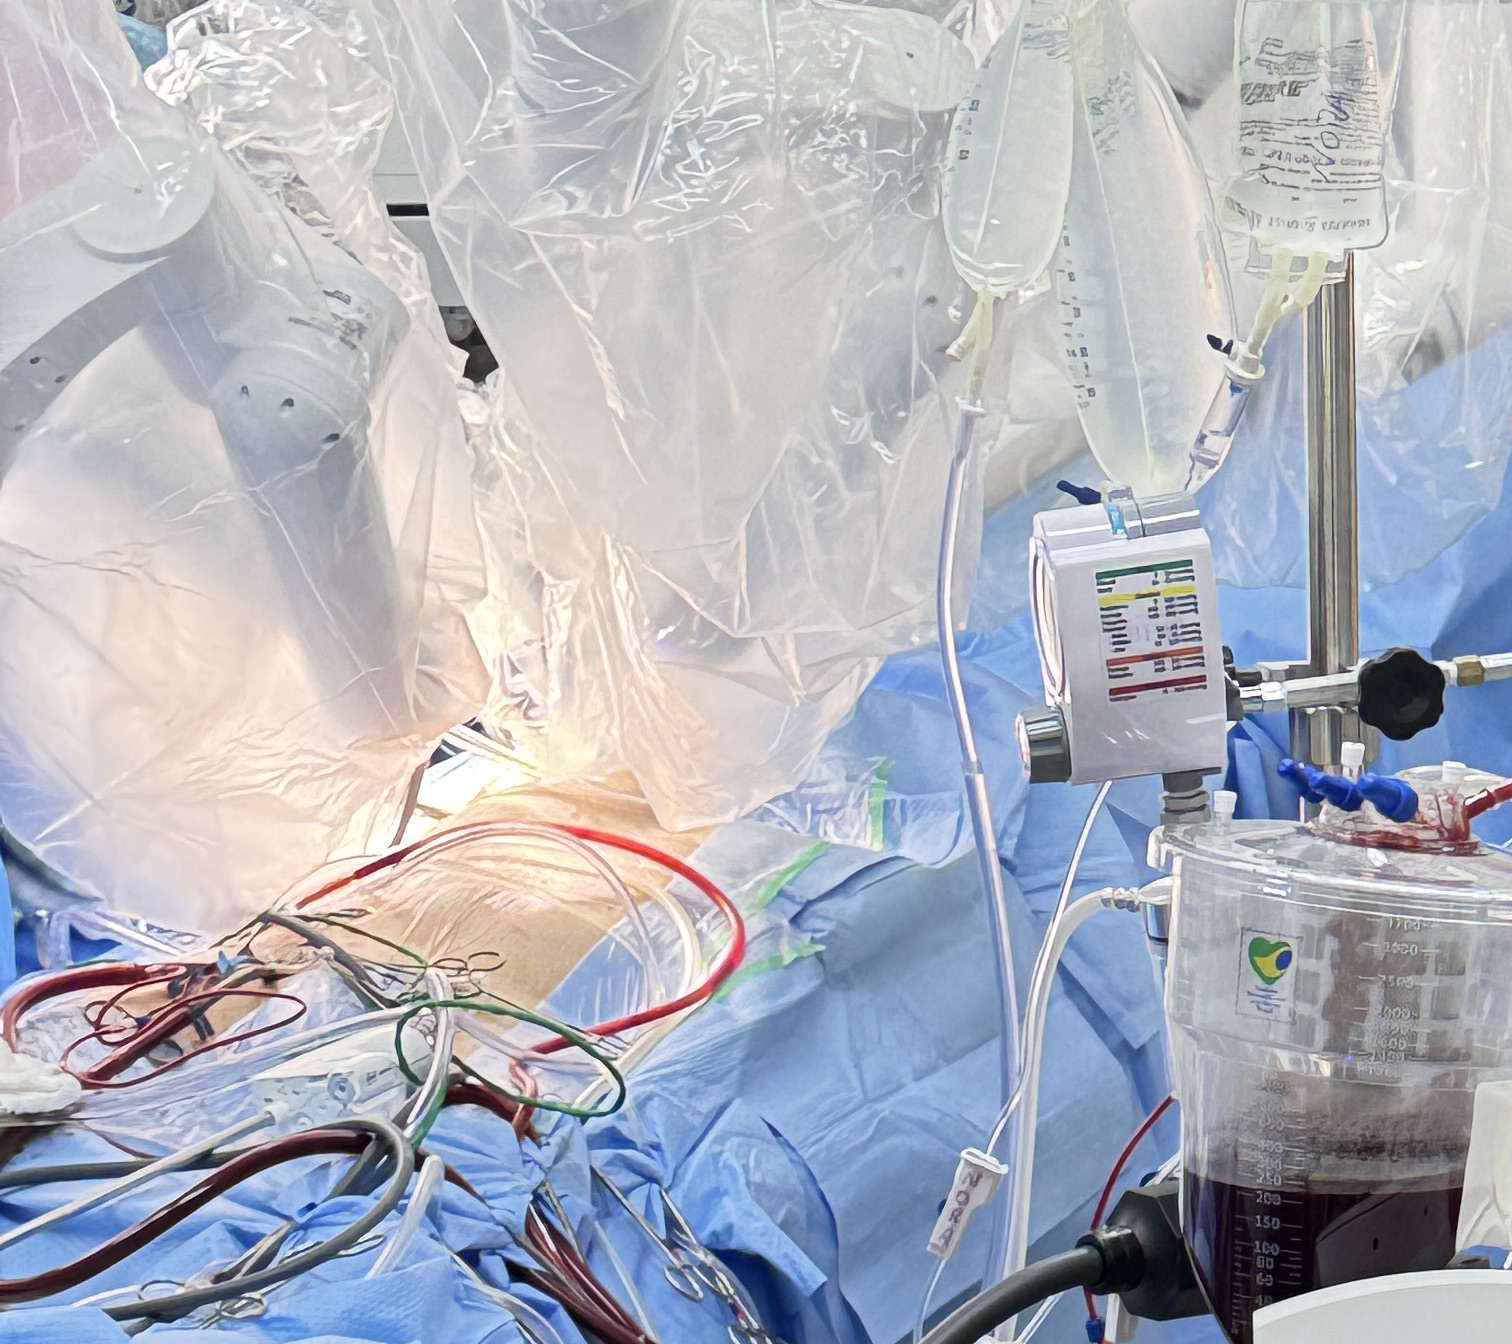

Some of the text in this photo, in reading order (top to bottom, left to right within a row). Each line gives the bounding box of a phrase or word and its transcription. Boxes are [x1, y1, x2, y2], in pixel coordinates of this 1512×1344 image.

[1255, 1190, 1281, 1206] 200
[1254, 1215, 1280, 1229] 150
[1253, 1240, 1280, 1256] 100
